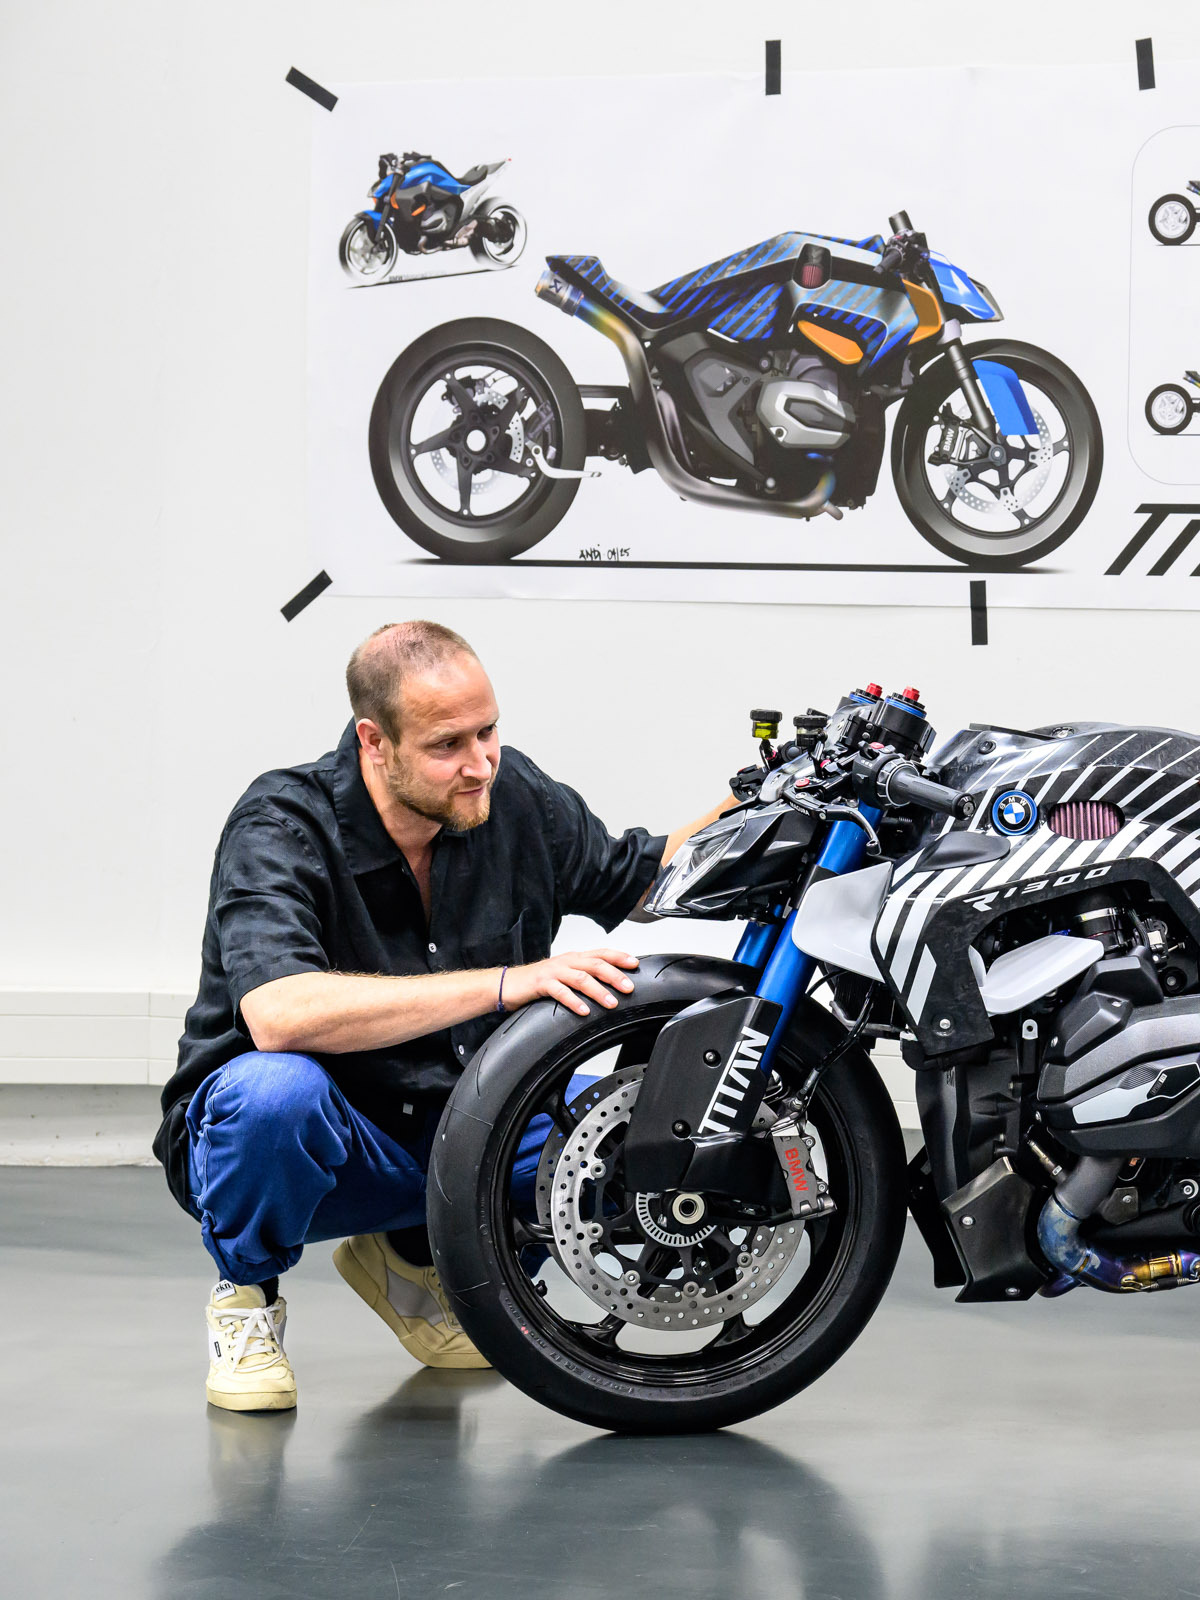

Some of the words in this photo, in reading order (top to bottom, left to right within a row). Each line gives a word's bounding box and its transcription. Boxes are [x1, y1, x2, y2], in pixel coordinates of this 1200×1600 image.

[943, 428, 955, 452] BMW
[697, 1025, 770, 1134] TITAN
[784, 1147, 809, 1192] BMW
